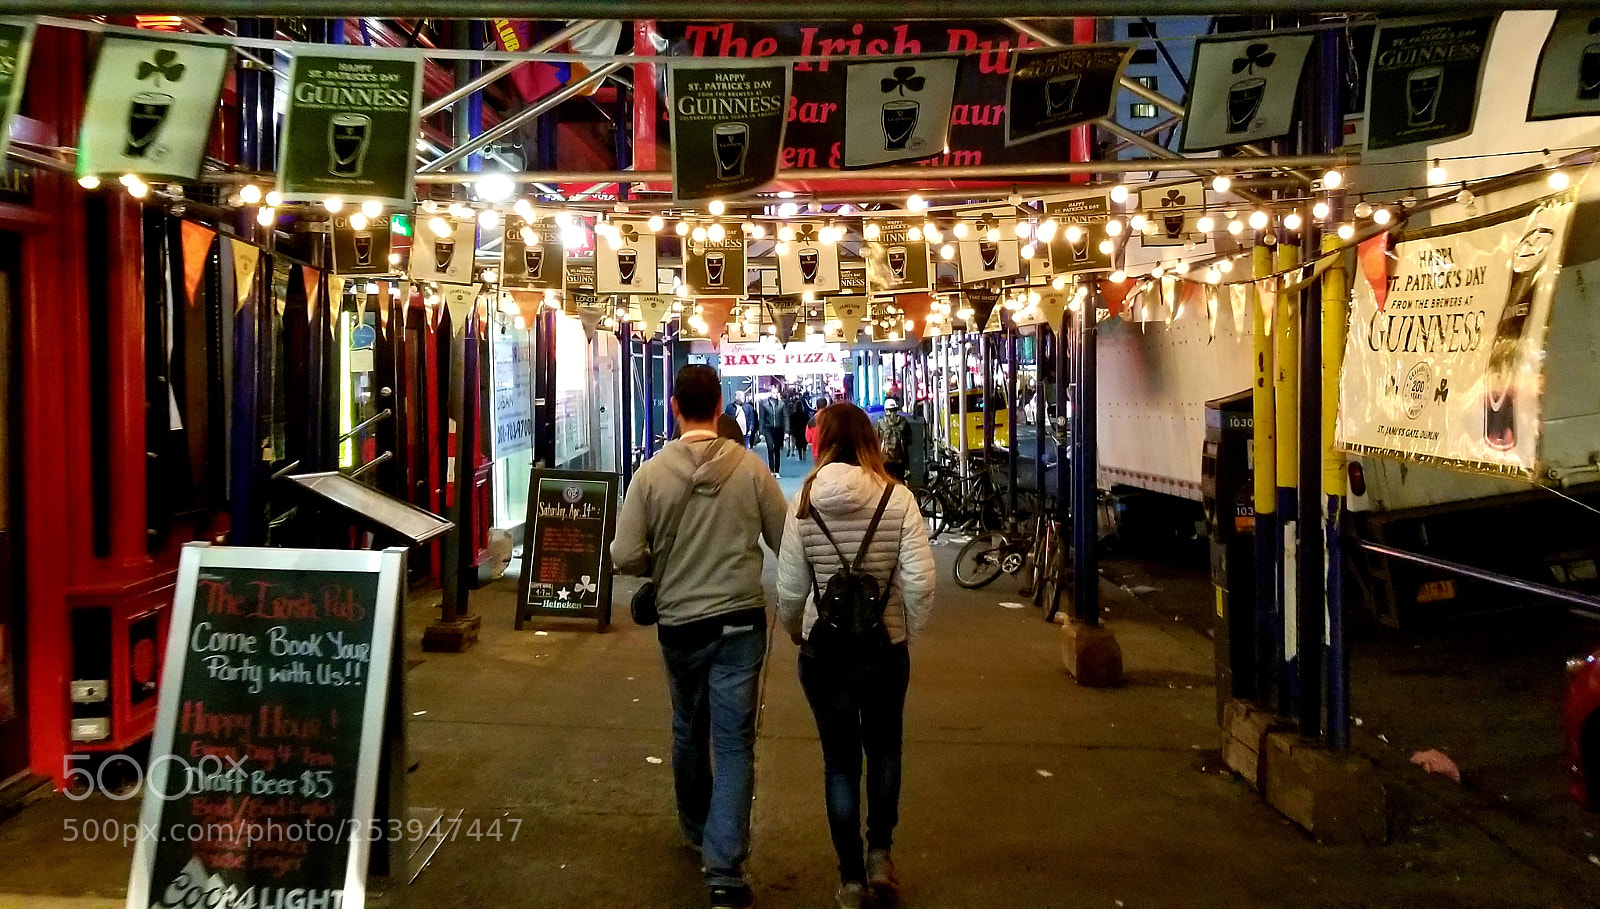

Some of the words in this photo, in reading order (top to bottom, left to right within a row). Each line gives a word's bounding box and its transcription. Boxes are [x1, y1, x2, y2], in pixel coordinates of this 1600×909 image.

[494, 19, 520, 52] LUB
[685, 23, 778, 58] The
[795, 23, 921, 72] Irish
[688, 83, 702, 91] ST.
[705, 81, 751, 90] PATRICK'S
[754, 80, 773, 89] DAY
[294, 81, 411, 107] GUINNESS
[678, 95, 781, 115] GUINNESS
[335, 217, 389, 228] GESS
[506, 229, 563, 241] GUNES
[687, 238, 743, 248] GINNESS
[566, 274, 594, 283] GUINN
[841, 278, 866, 287] NNESS
[1404, 269, 1462, 292] PATRICK'S
[1465, 266, 1488, 287] DAY
[1391, 299, 1412, 309] FROM
[1415, 298, 1428, 309] THE
[1431, 297, 1463, 309] BREWERS
[1464, 295, 1474, 306] AT
[1368, 308, 1486, 353] GUINNESS
[724, 354, 776, 366] RAY'S
[785, 352, 837, 364] PIZZA
[1411, 380, 1425, 393] 200
[1229, 418, 1253, 428] 1030
[542, 599, 582, 609] Heineken
[191, 621, 258, 654] Come
[265, 625, 323, 657] Book
[326, 631, 371, 663] Your
[201, 654, 262, 694] Party
[269, 661, 314, 685] with
[316, 661, 362, 686] Us!!
[250, 769, 298, 796] Beer
[301, 769, 334, 798] $5
[260, 887, 345, 909] LIGHT
